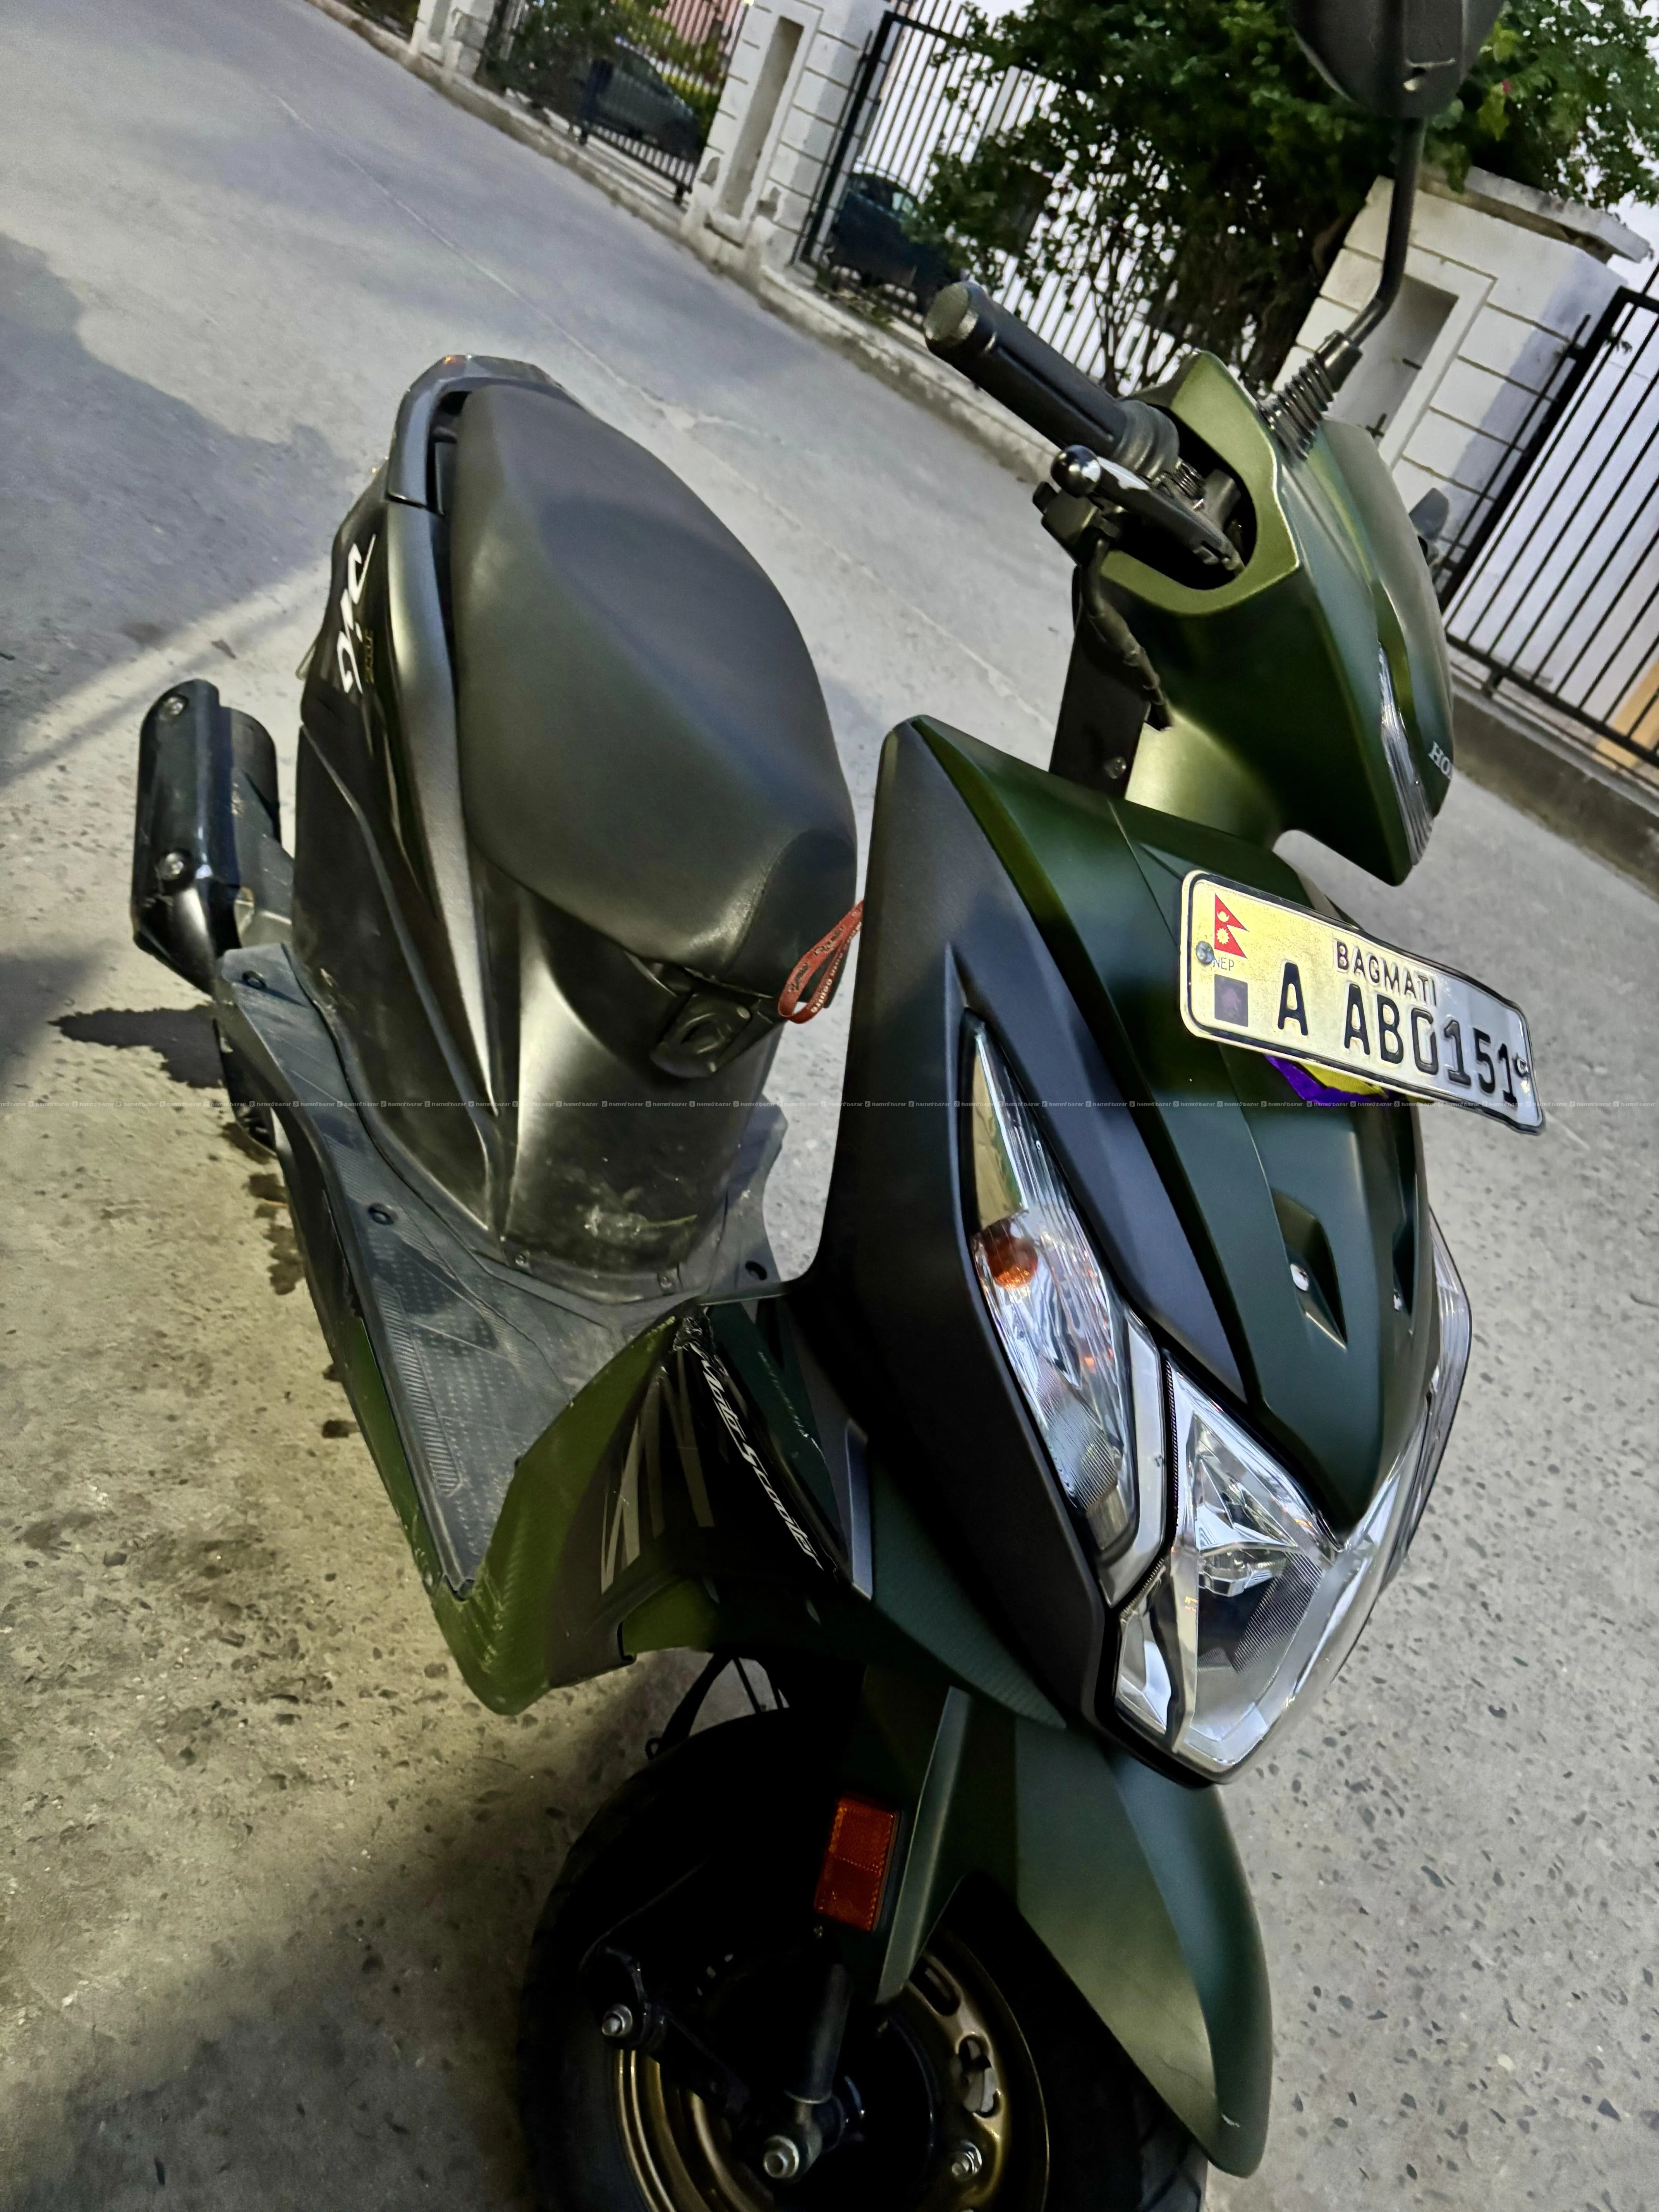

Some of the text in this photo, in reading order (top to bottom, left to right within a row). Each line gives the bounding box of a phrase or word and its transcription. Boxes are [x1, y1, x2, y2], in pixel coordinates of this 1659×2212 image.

[1213, 956, 1234, 971] NEP
[1337, 941, 1437, 1006] BAGMATI
[1278, 962, 1308, 1036] A
[690, 1343, 824, 1571] Moto Scooter
